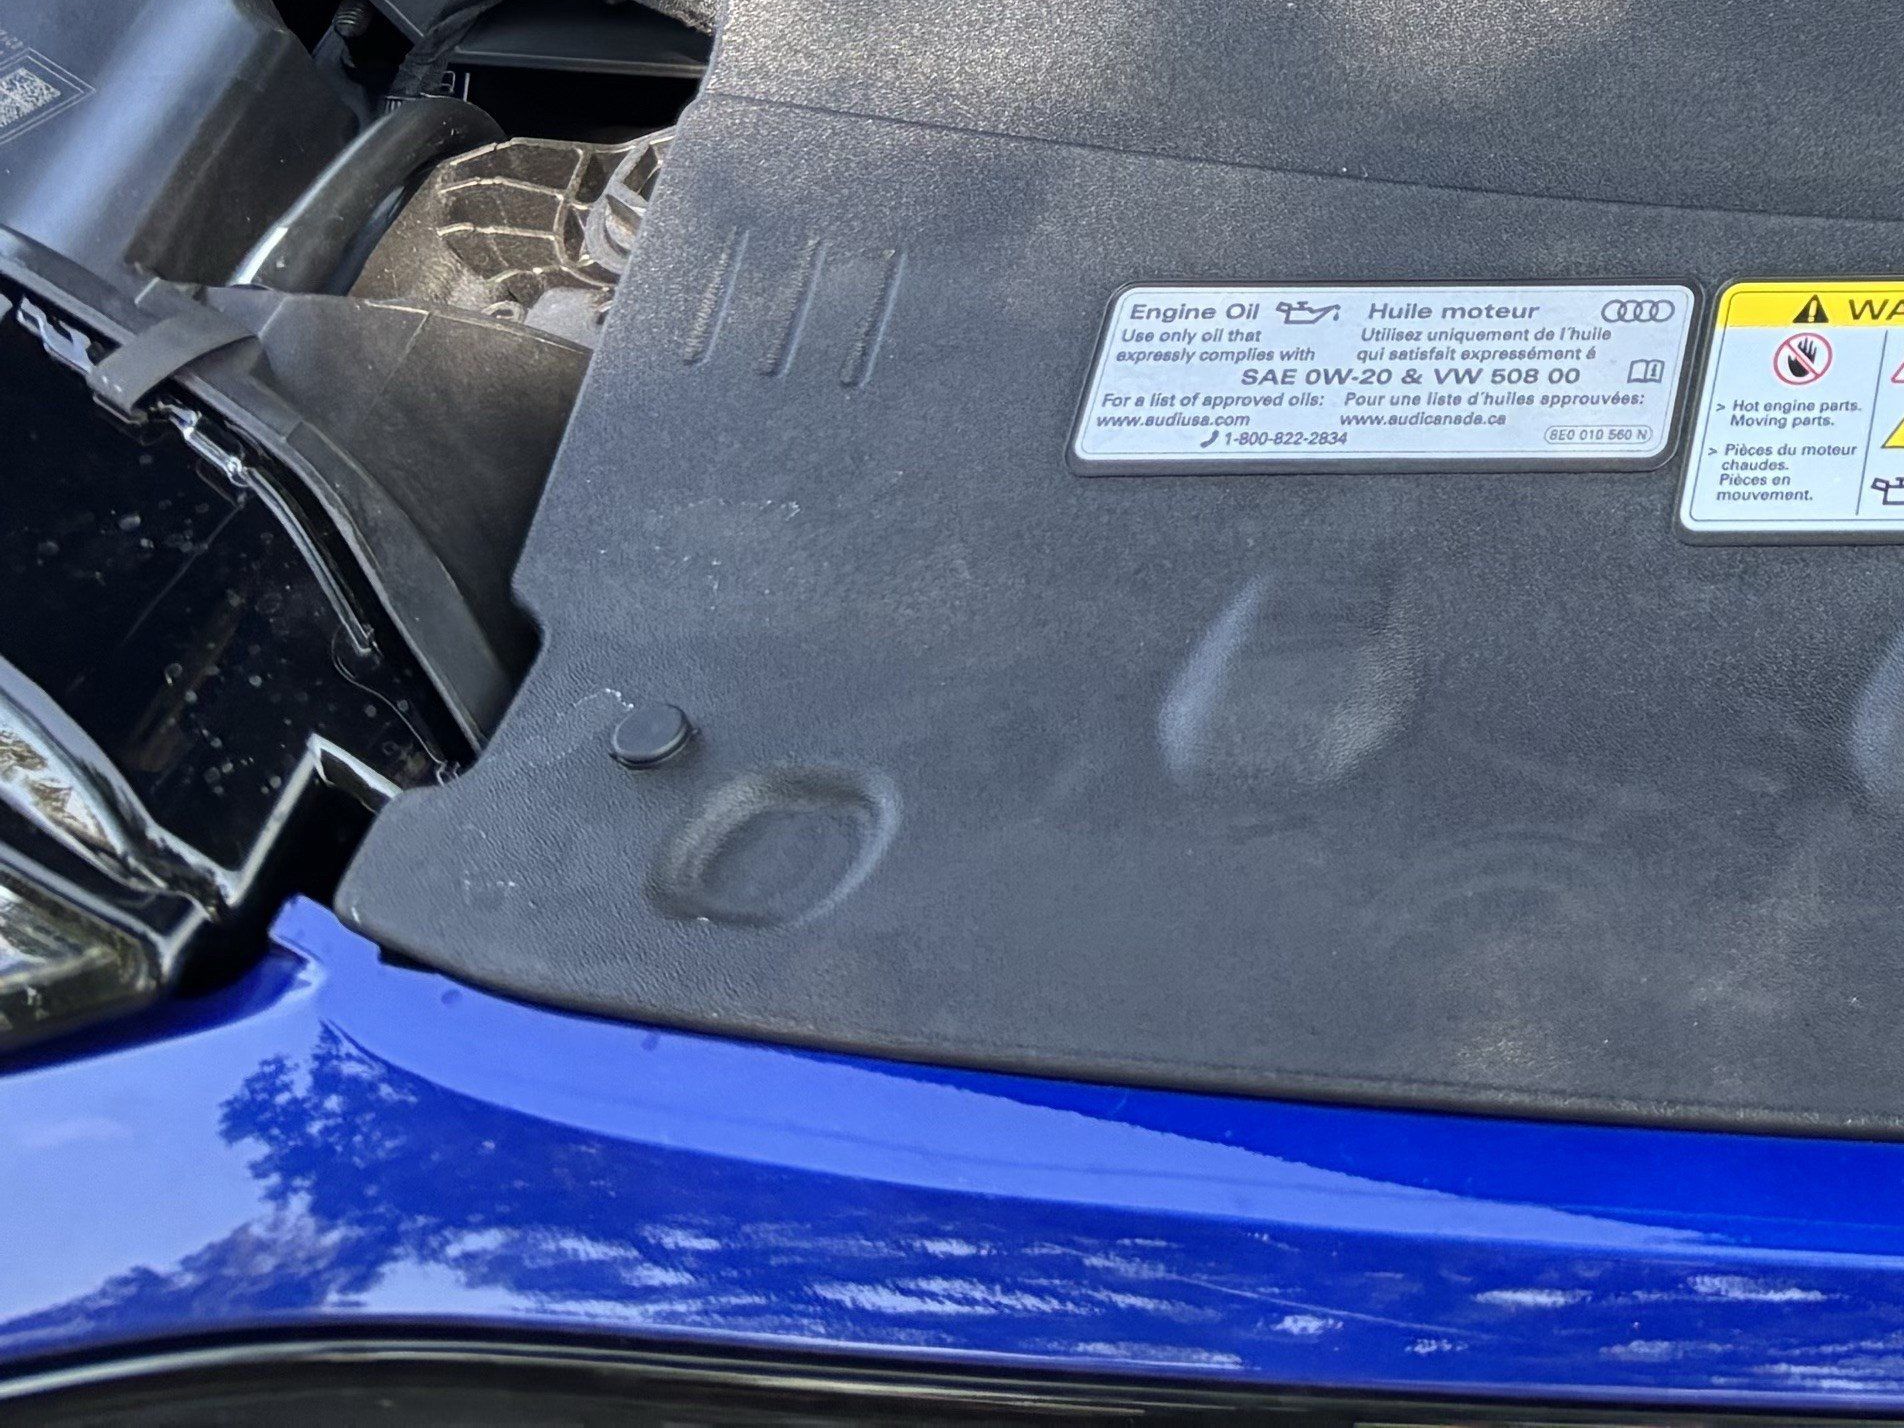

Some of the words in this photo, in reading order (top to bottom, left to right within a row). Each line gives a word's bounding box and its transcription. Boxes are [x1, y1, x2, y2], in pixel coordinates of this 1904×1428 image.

[1128, 302, 1217, 323] Engine
[1224, 302, 1260, 320] Oil
[1366, 301, 1433, 320] Huile
[1440, 303, 1541, 319] moteur
[1120, 327, 1155, 343] Use
[1157, 327, 1197, 346] only
[1200, 327, 1224, 343] oil
[1226, 327, 1262, 343] that
[1359, 326, 1423, 342] Utilisez
[1425, 326, 1530, 345] uniquement
[1532, 325, 1555, 342] de
[1115, 346, 1196, 365] expressly
[1197, 346, 1275, 364] complies
[1278, 345, 1316, 362] with
[1355, 345, 1386, 364] qui
[1387, 345, 1457, 361] satisfait
[1239, 367, 1298, 386] SAE
[1304, 367, 1393, 386] 0W-20
[1399, 367, 1423, 385] &
[1432, 366, 1484, 385] VW
[1489, 367, 1540, 385] 508
[1546, 366, 1581, 385] 00
[1100, 392, 1132, 408] For
[1133, 395, 1145, 407] a
[1148, 391, 1176, 408] list
[1178, 391, 1201, 407] of
[1200, 391, 1285, 410] approved
[1287, 391, 1325, 407] oils:
[1343, 390, 1386, 407] Pour
[1388, 393, 1422, 407] une
[1425, 390, 1462, 407] liste
[1731, 398, 1760, 412] Hot
[1762, 398, 1816, 415] engine
[1095, 411, 1251, 427] www.audiusa.com
[1339, 410, 1507, 426] www.audicanada.ca
[1729, 413, 1788, 430] Moving
[1224, 430, 1348, 446] 1-800-822-2834
[1548, 427, 1576, 441] 8E0
[1578, 427, 1604, 441] 010
[1606, 427, 1633, 441] 560
[1775, 442, 1797, 456] du
[1800, 443, 1858, 456] moteur
[1770, 475, 1791, 486] en
